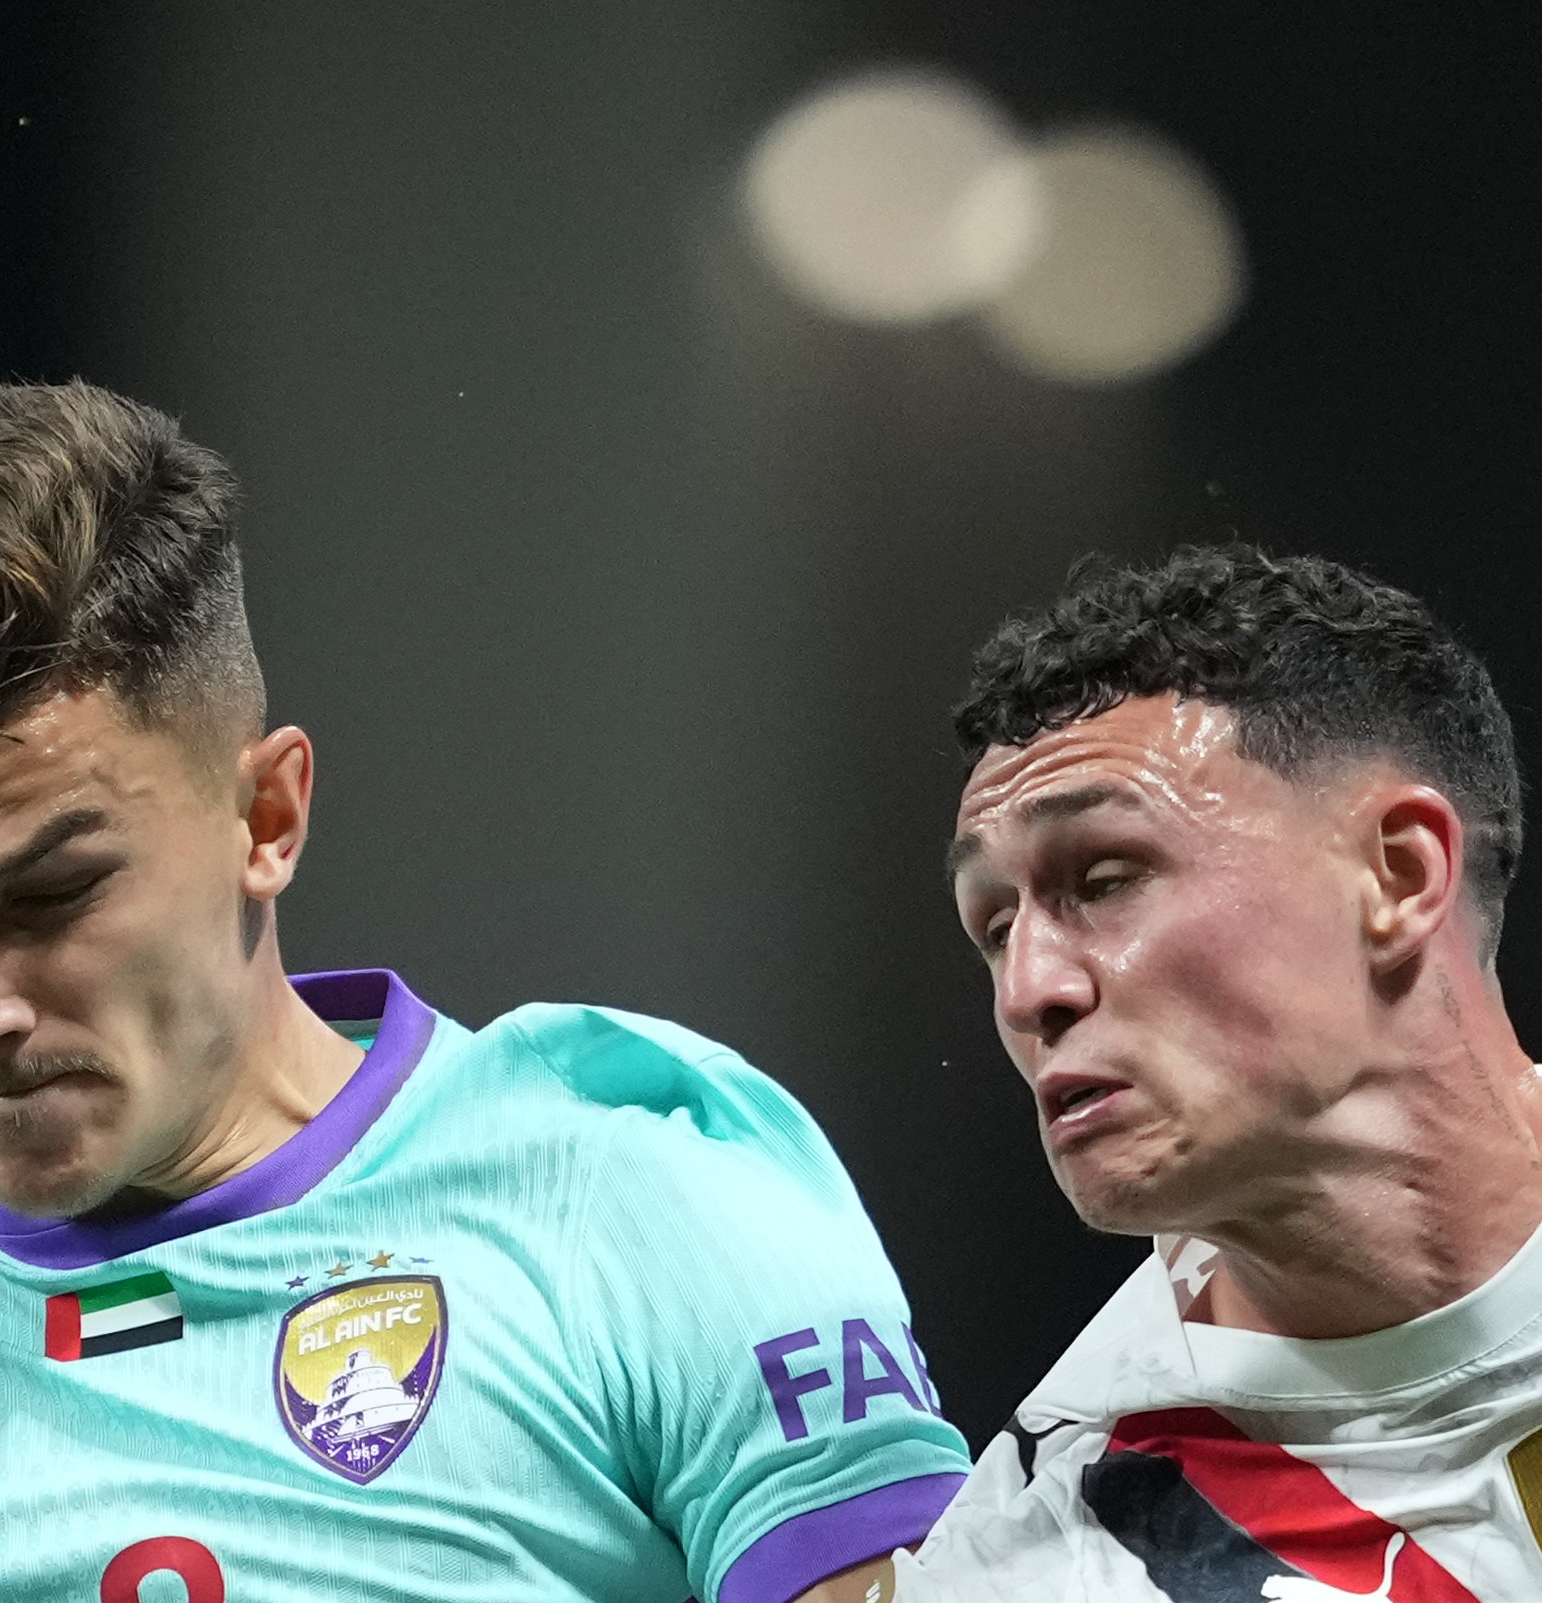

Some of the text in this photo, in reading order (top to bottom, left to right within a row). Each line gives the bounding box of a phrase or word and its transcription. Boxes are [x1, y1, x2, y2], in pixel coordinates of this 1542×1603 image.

[298, 1327, 331, 1355] AL
[335, 1311, 382, 1343] AIN
[385, 1303, 422, 1329] FC
[346, 1444, 380, 1462] 1968
